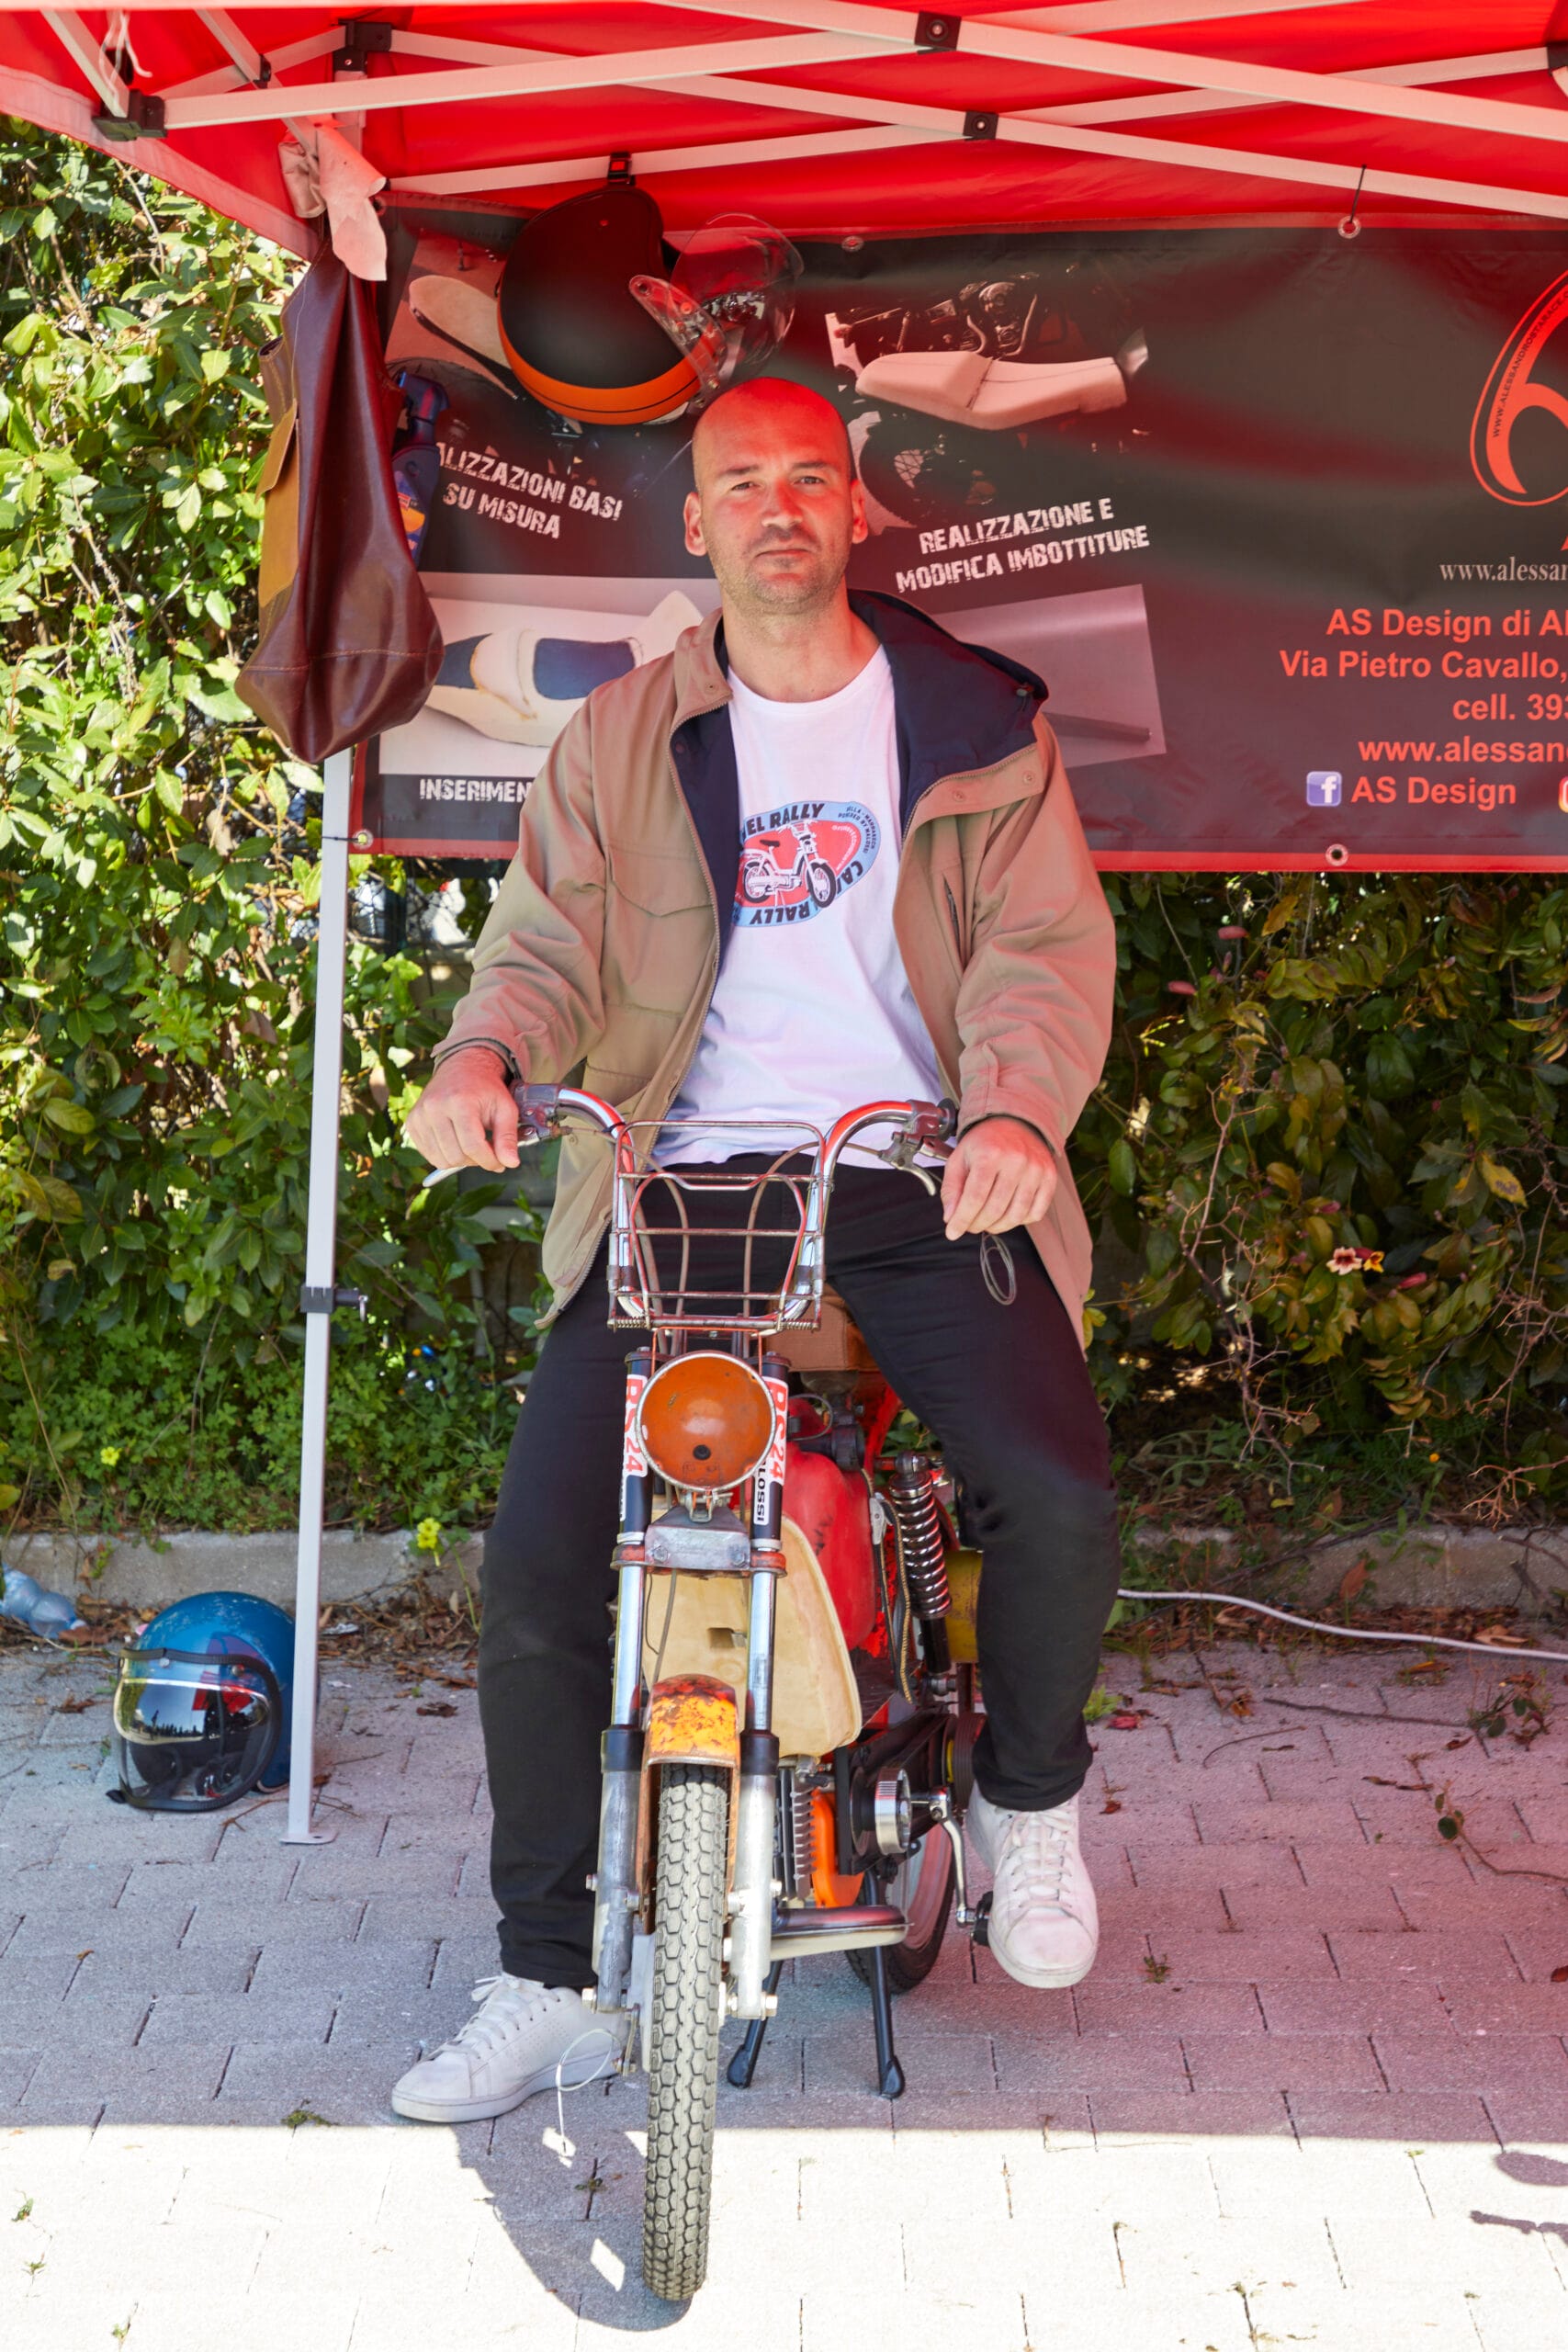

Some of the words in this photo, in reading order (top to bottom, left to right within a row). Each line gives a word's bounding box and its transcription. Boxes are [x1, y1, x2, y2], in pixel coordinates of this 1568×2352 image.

[442, 481, 477, 512] SU
[477, 493, 561, 540] MISURA
[568, 485, 624, 522] BASI
[919, 501, 1095, 555] REALIZZAZIONE
[1099, 497, 1114, 520] E
[896, 555, 1004, 594] MODIFICA
[1008, 525, 1150, 572] IMBOTTITURE
[1326, 608, 1372, 636] AS
[1382, 608, 1492, 643] Design
[1502, 609, 1531, 637] di
[1280, 650, 1327, 677] Via
[1339, 650, 1432, 678] Pietro
[1441, 650, 1568, 683] Cavallo,
[1452, 693, 1516, 721] cell.
[1358, 735, 1568, 763] www.alessan
[419, 778, 533, 803] INSERIMEN
[1351, 776, 1397, 804] AS
[1407, 776, 1517, 811] Design
[742, 816, 765, 837] EL
[770, 803, 825, 829] RALLY
[750, 901, 811, 924] RALLY
[756, 1463, 766, 1521] LOSSI
